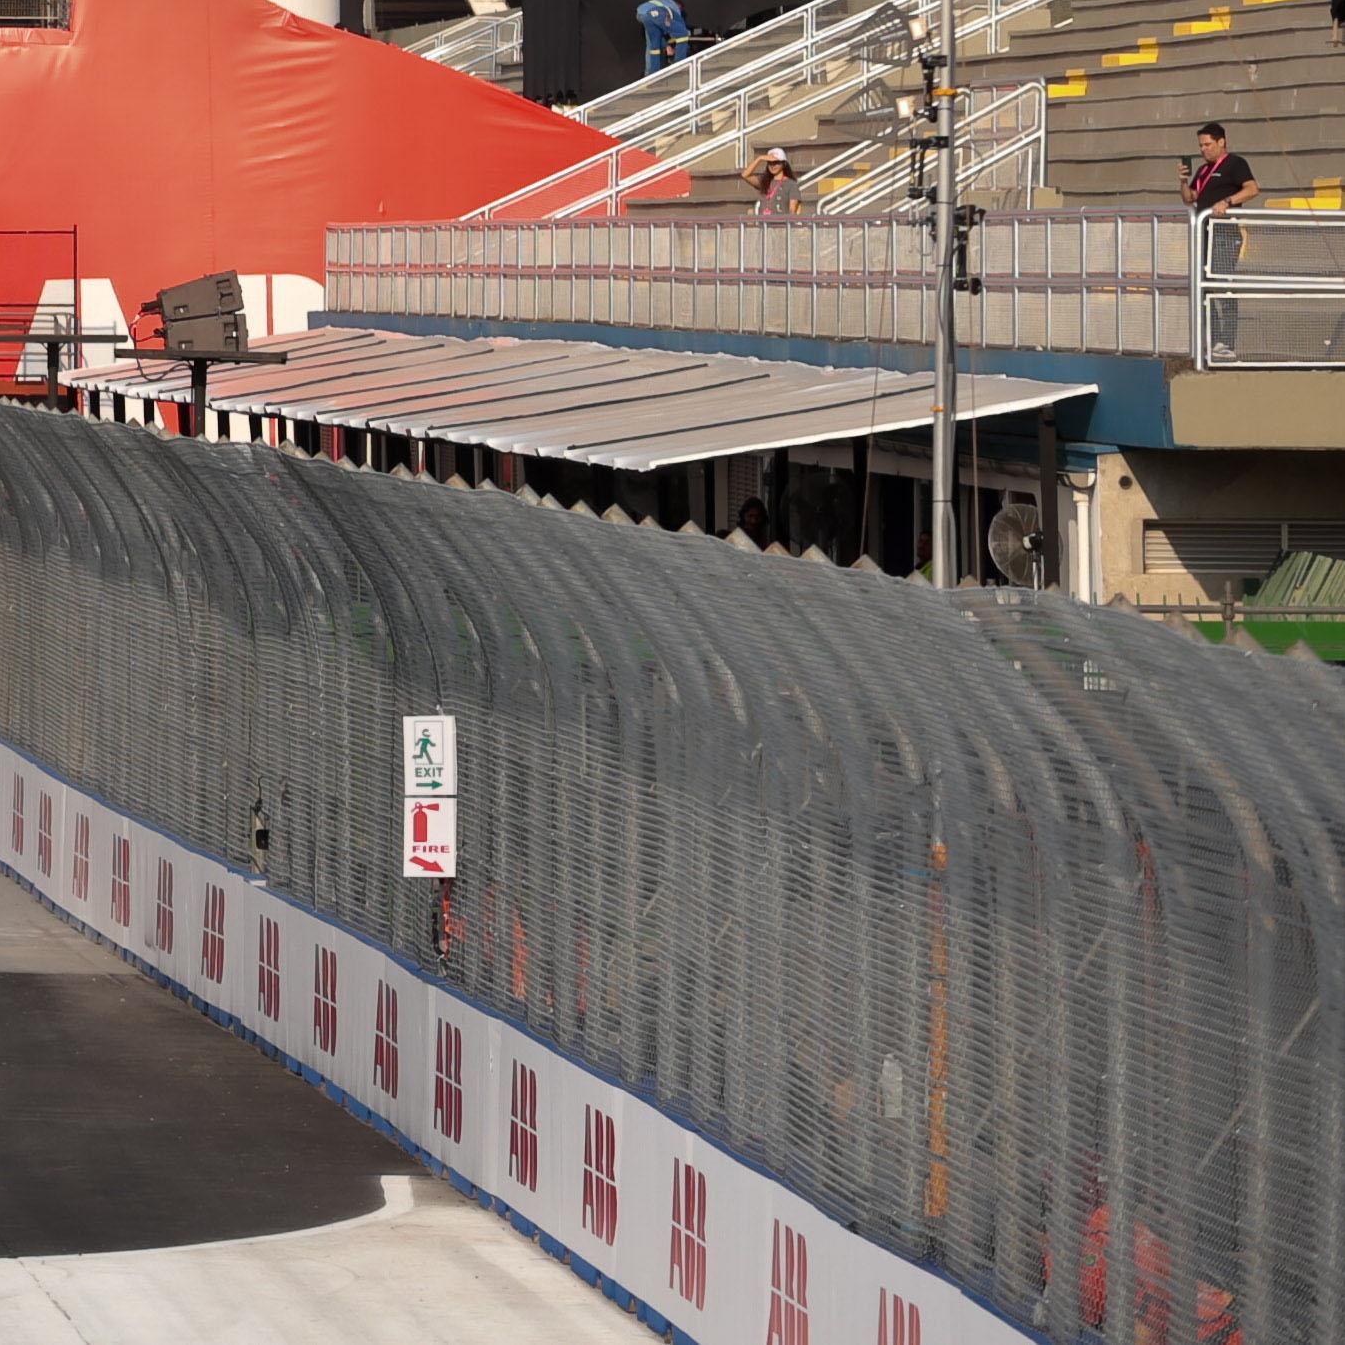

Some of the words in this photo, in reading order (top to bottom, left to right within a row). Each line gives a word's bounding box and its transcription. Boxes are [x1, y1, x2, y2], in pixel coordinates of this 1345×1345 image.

[414, 766, 445, 778] EXIT
[72, 812, 90, 903] ABB
[111, 833, 130, 928] ABB
[412, 844, 451, 854] FIRE
[156, 856, 174, 955] ABB
[201, 882, 225, 985] ABB
[258, 913, 280, 1023] ABB
[313, 943, 337, 1057] ABB
[373, 979, 398, 1100] ABB
[433, 1017, 463, 1145] ABB
[509, 1057, 538, 1193] ABB
[582, 1103, 618, 1247] ABB
[669, 1157, 707, 1312] ABB
